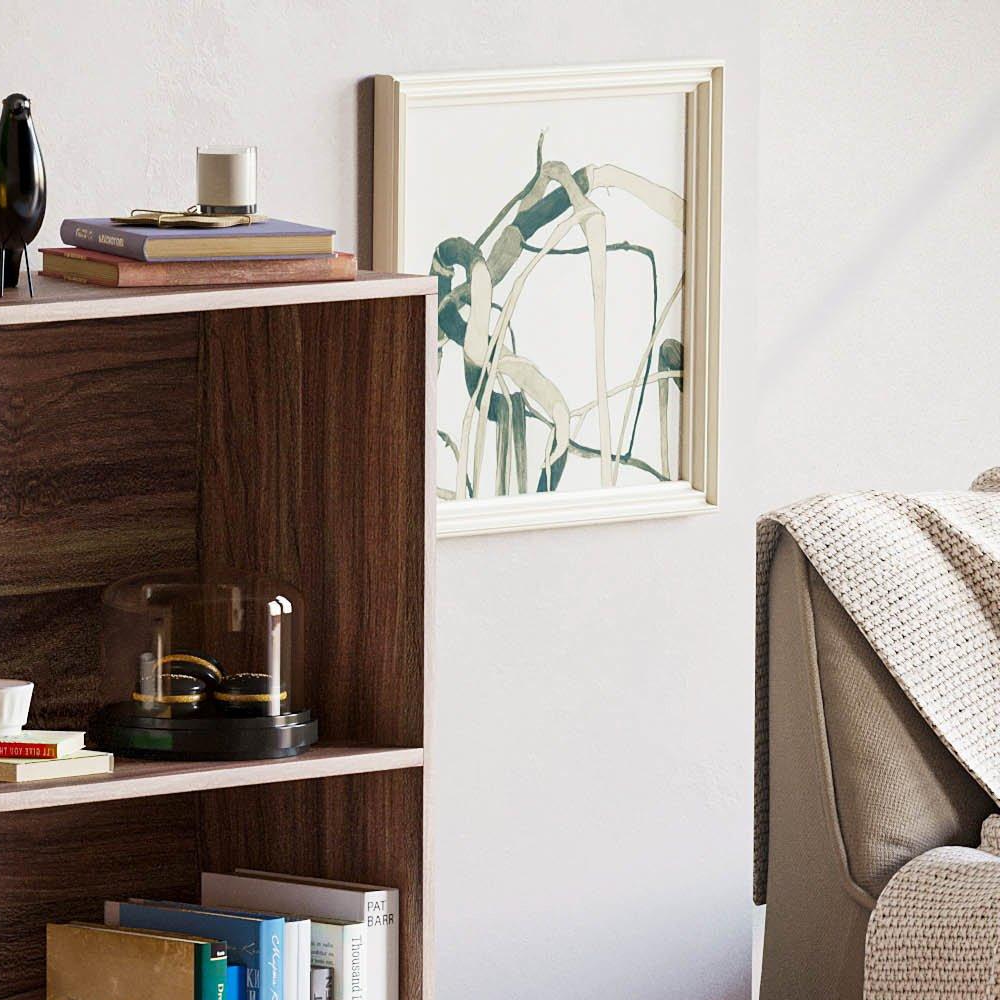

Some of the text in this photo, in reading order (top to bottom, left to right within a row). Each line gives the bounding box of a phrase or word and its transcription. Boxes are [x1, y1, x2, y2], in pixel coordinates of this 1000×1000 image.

[367, 900, 385, 912] PAT
[367, 913, 394, 927] BARR
[351, 935, 363, 992] Thousand
